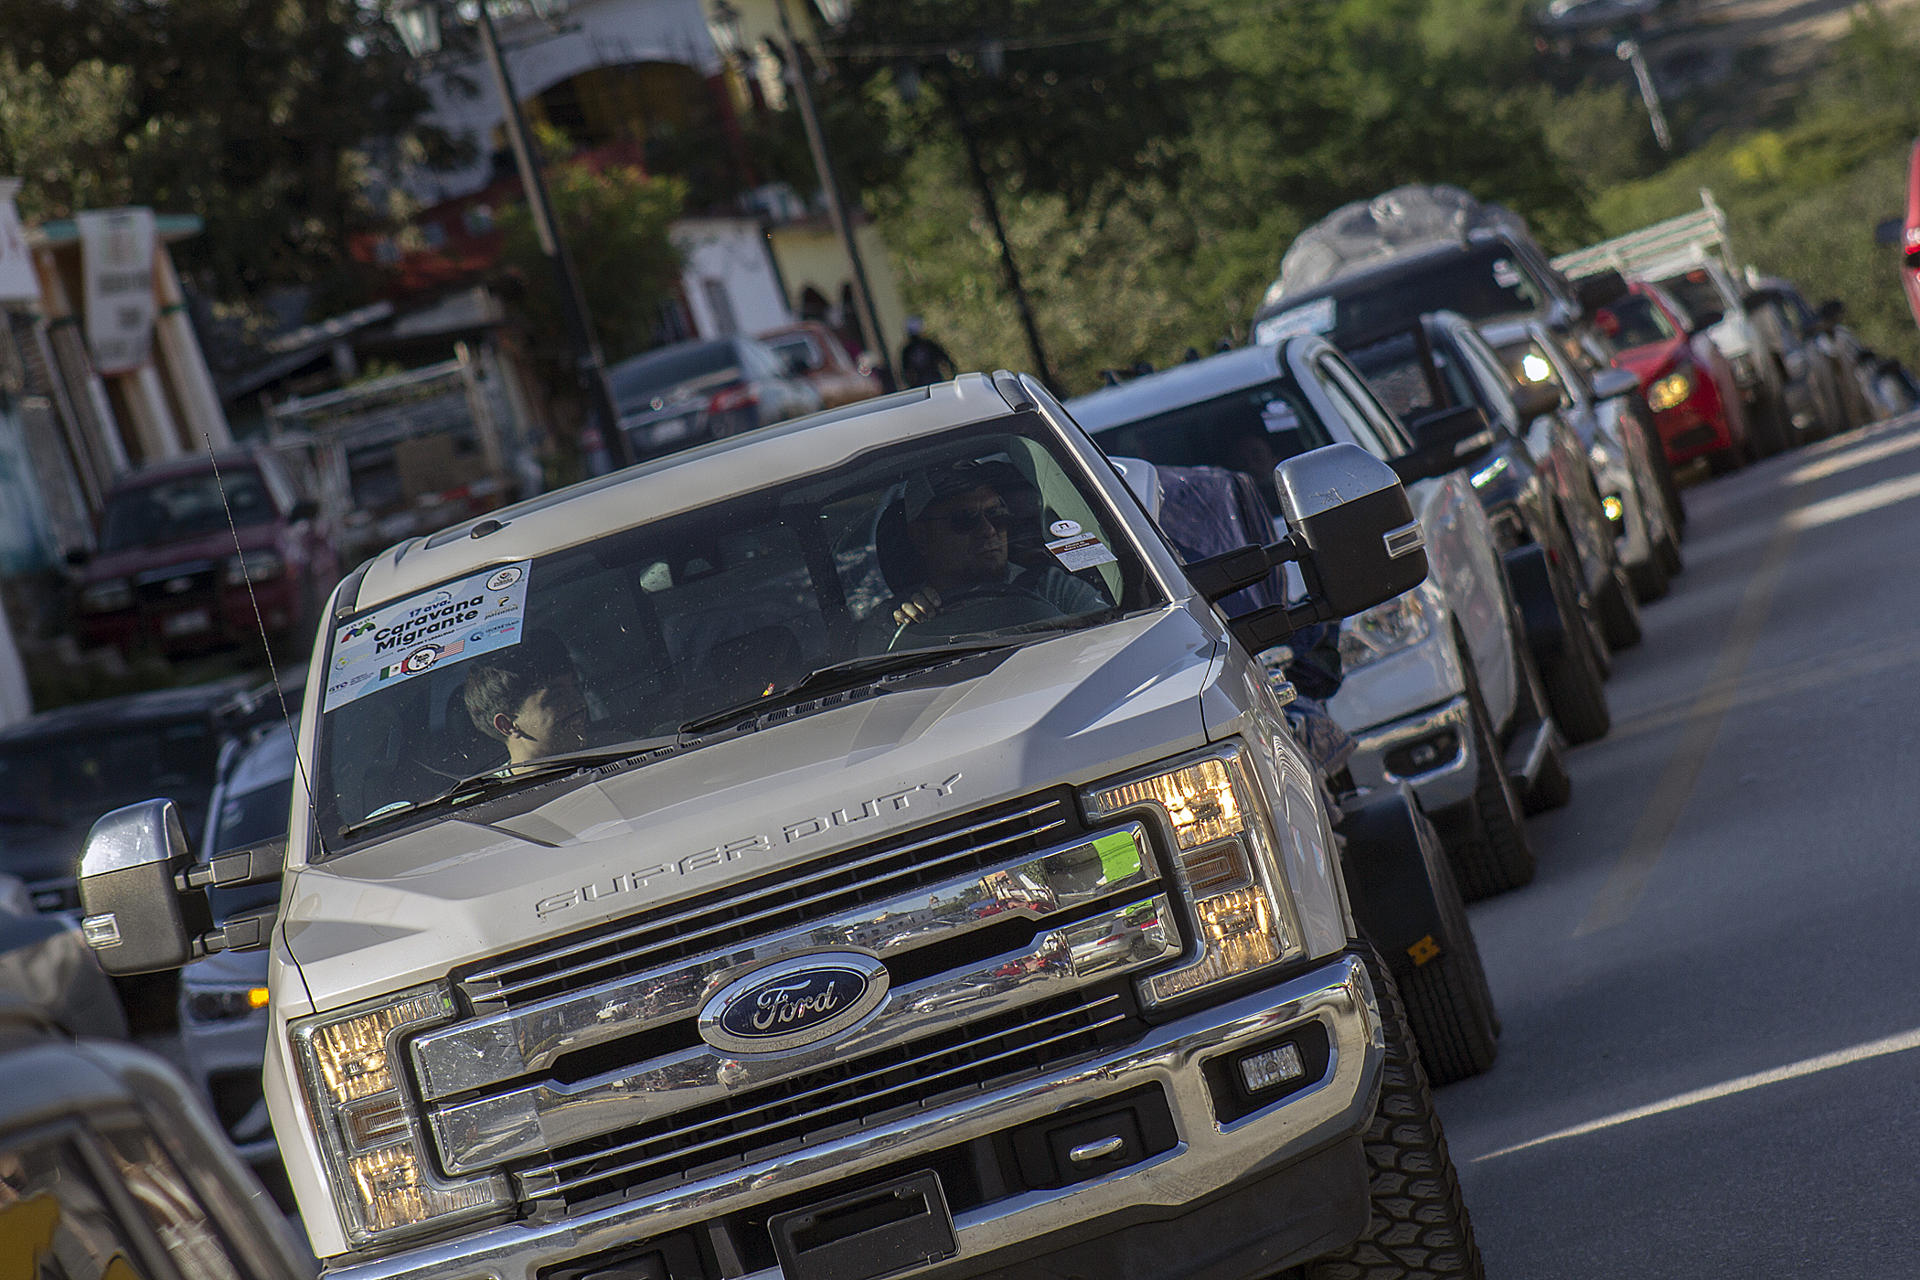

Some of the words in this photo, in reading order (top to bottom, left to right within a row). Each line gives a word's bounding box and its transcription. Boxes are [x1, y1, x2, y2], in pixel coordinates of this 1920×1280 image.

[373, 594, 484, 642] Caravana
[375, 609, 479, 655] Migrante
[409, 607, 422, 618] 17
[535, 834, 771, 921] SUPER
[783, 772, 963, 844] DUTY
[753, 979, 838, 1030] Ford
